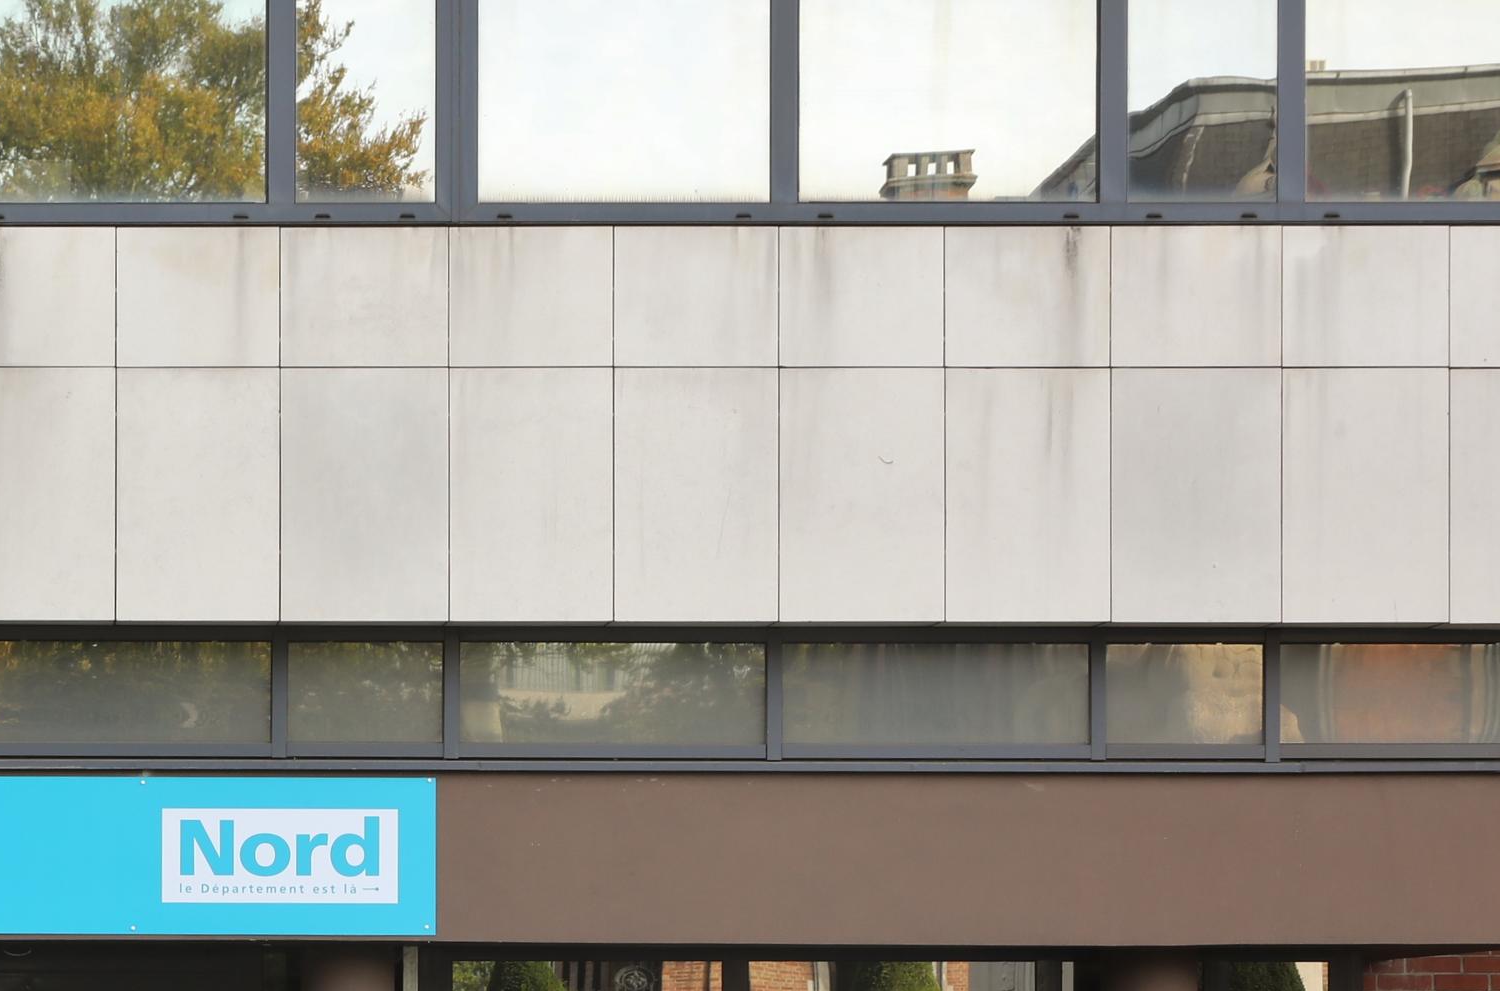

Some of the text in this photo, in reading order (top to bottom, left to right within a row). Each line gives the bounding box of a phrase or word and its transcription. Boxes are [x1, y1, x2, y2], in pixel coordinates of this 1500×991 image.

[179, 815, 380, 878] Nord
[179, 882, 357, 897] le Département est là
